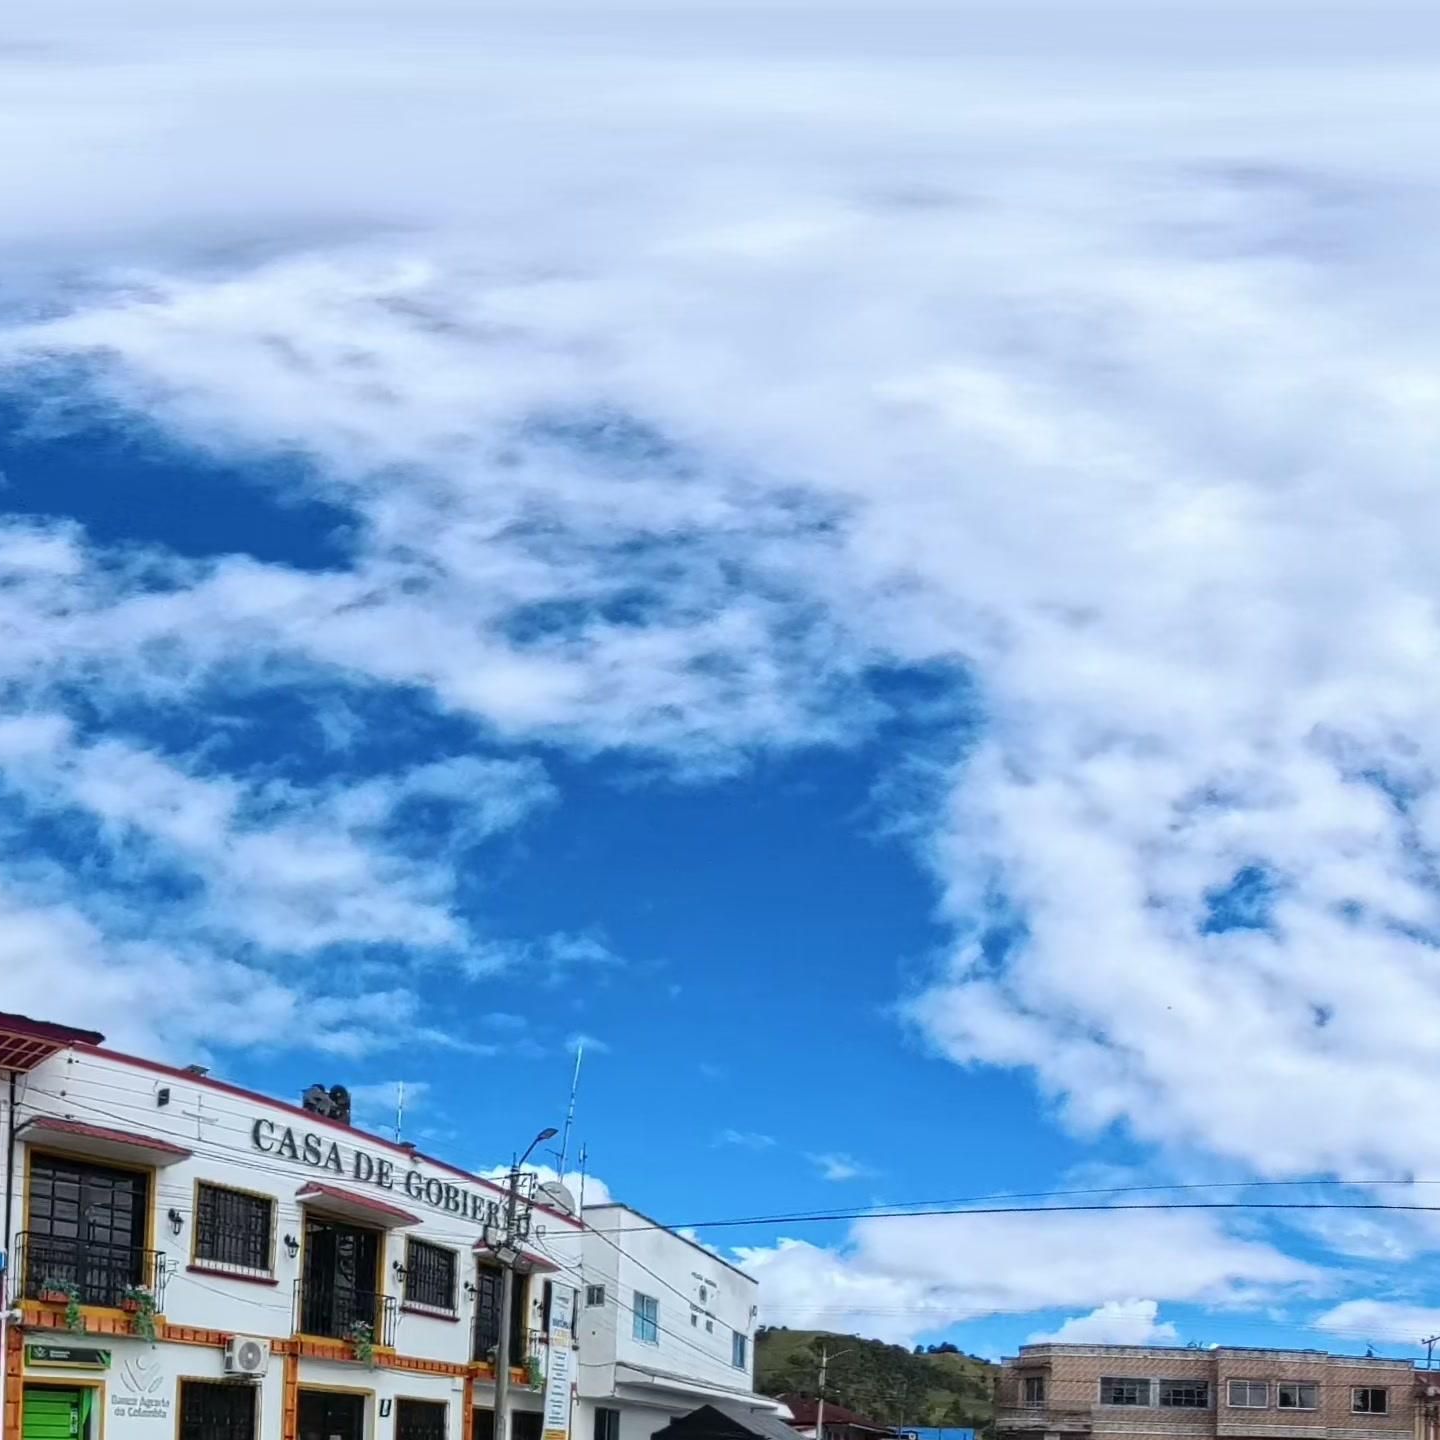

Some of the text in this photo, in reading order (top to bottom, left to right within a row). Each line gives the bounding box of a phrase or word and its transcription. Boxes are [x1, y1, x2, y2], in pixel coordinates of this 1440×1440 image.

[252, 1118, 344, 1173] CASA
[353, 1150, 394, 1189] DE
[111, 1394, 170, 1409] Banco Agrario
[128, 1407, 167, 1419] Colombia
